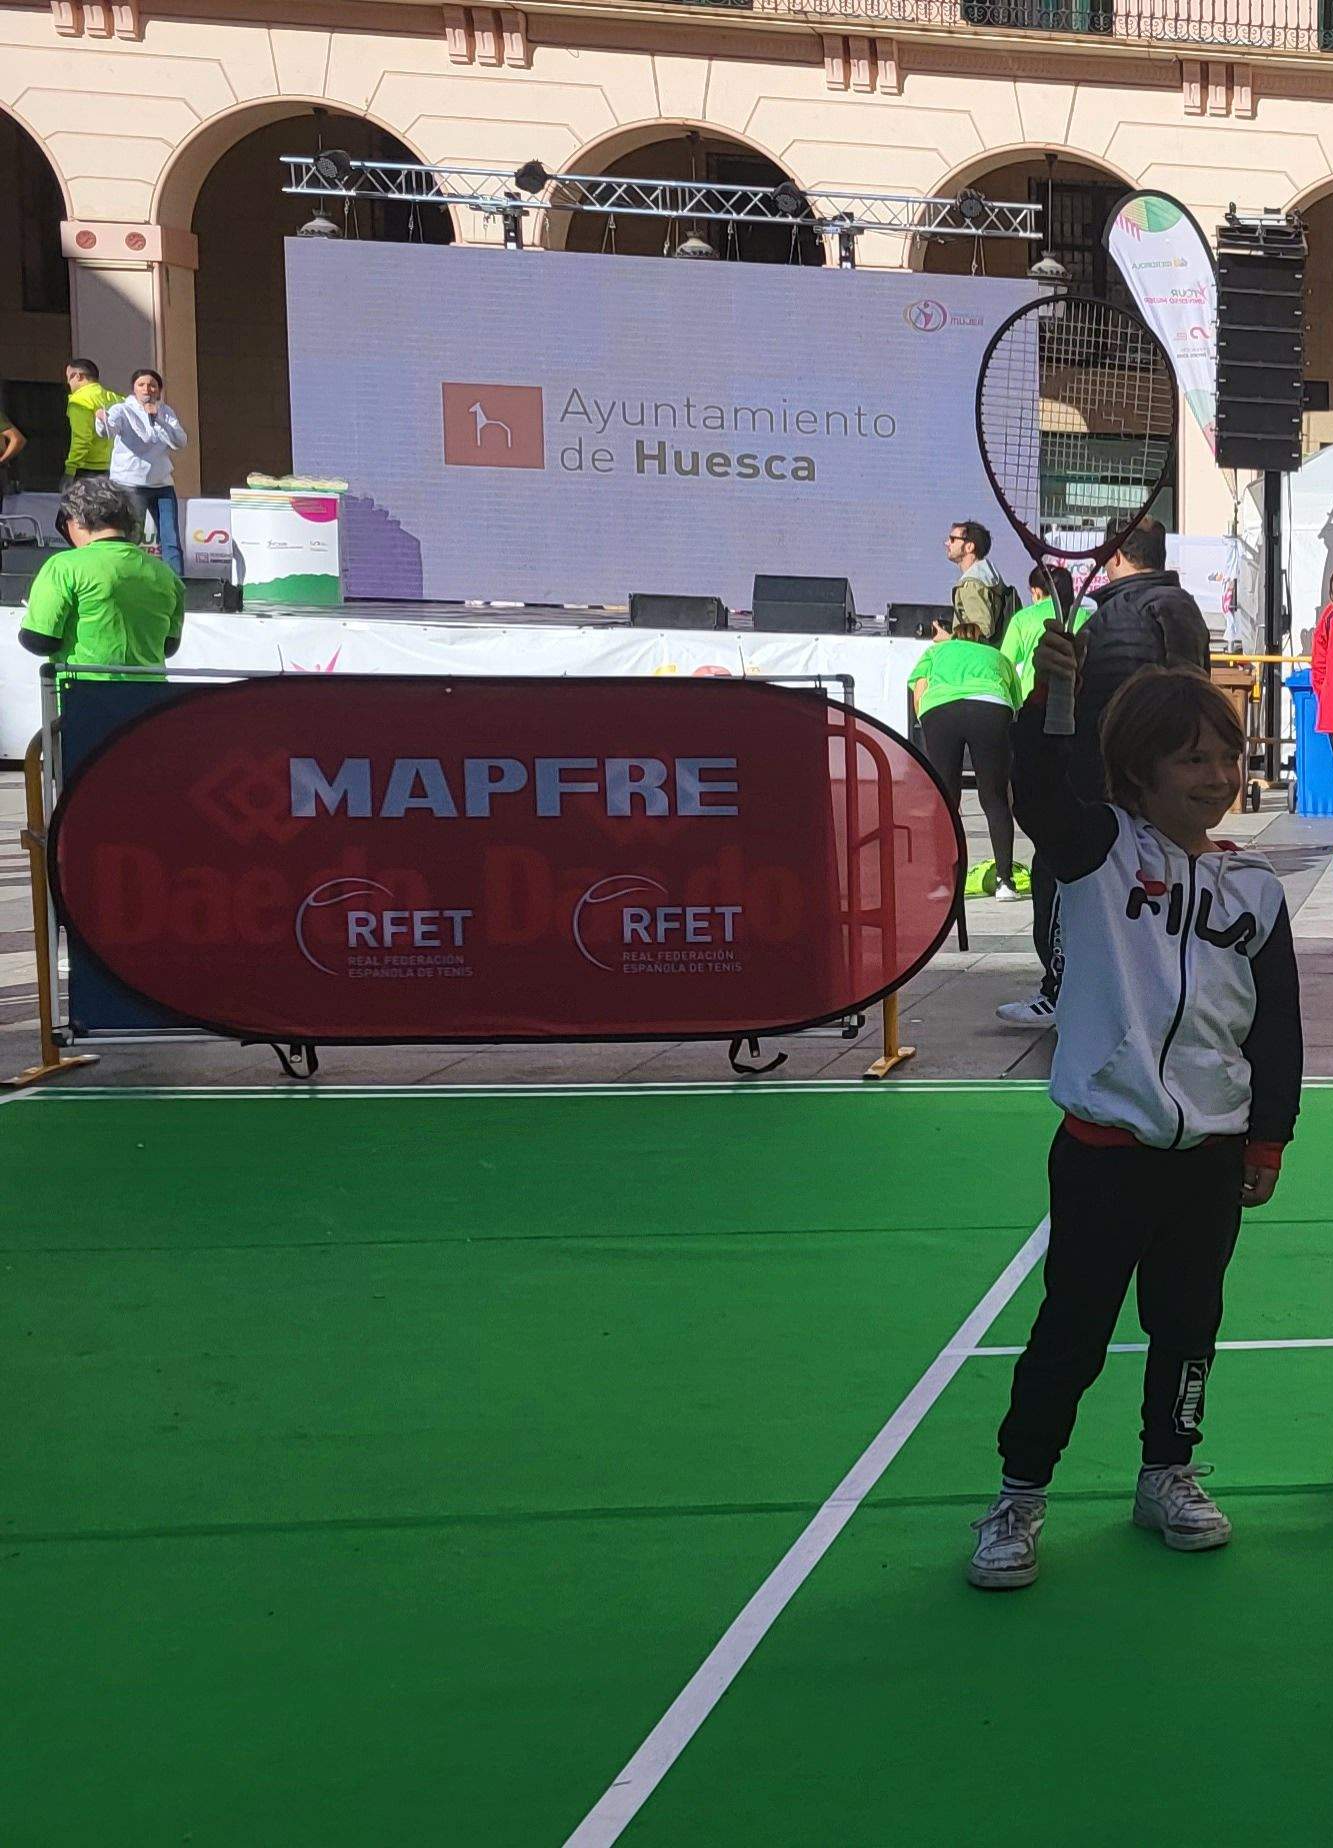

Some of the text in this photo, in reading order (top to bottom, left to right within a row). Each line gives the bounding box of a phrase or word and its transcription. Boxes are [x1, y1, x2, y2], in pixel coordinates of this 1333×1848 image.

[559, 387, 897, 439] Ayuntamiento
[559, 437, 817, 483] de Huesca
[288, 756, 740, 818] MAPFRE
[346, 908, 474, 949] RFET
[622, 905, 743, 945] RFET
[347, 953, 465, 967] REAL FEDERACIÓN
[348, 966, 474, 979] ESPAÑOLA DE TENIS
[622, 949, 735, 962] REAL FEDERACIÓN
[623, 961, 743, 974] ESPAÑOLA DE TENIS
